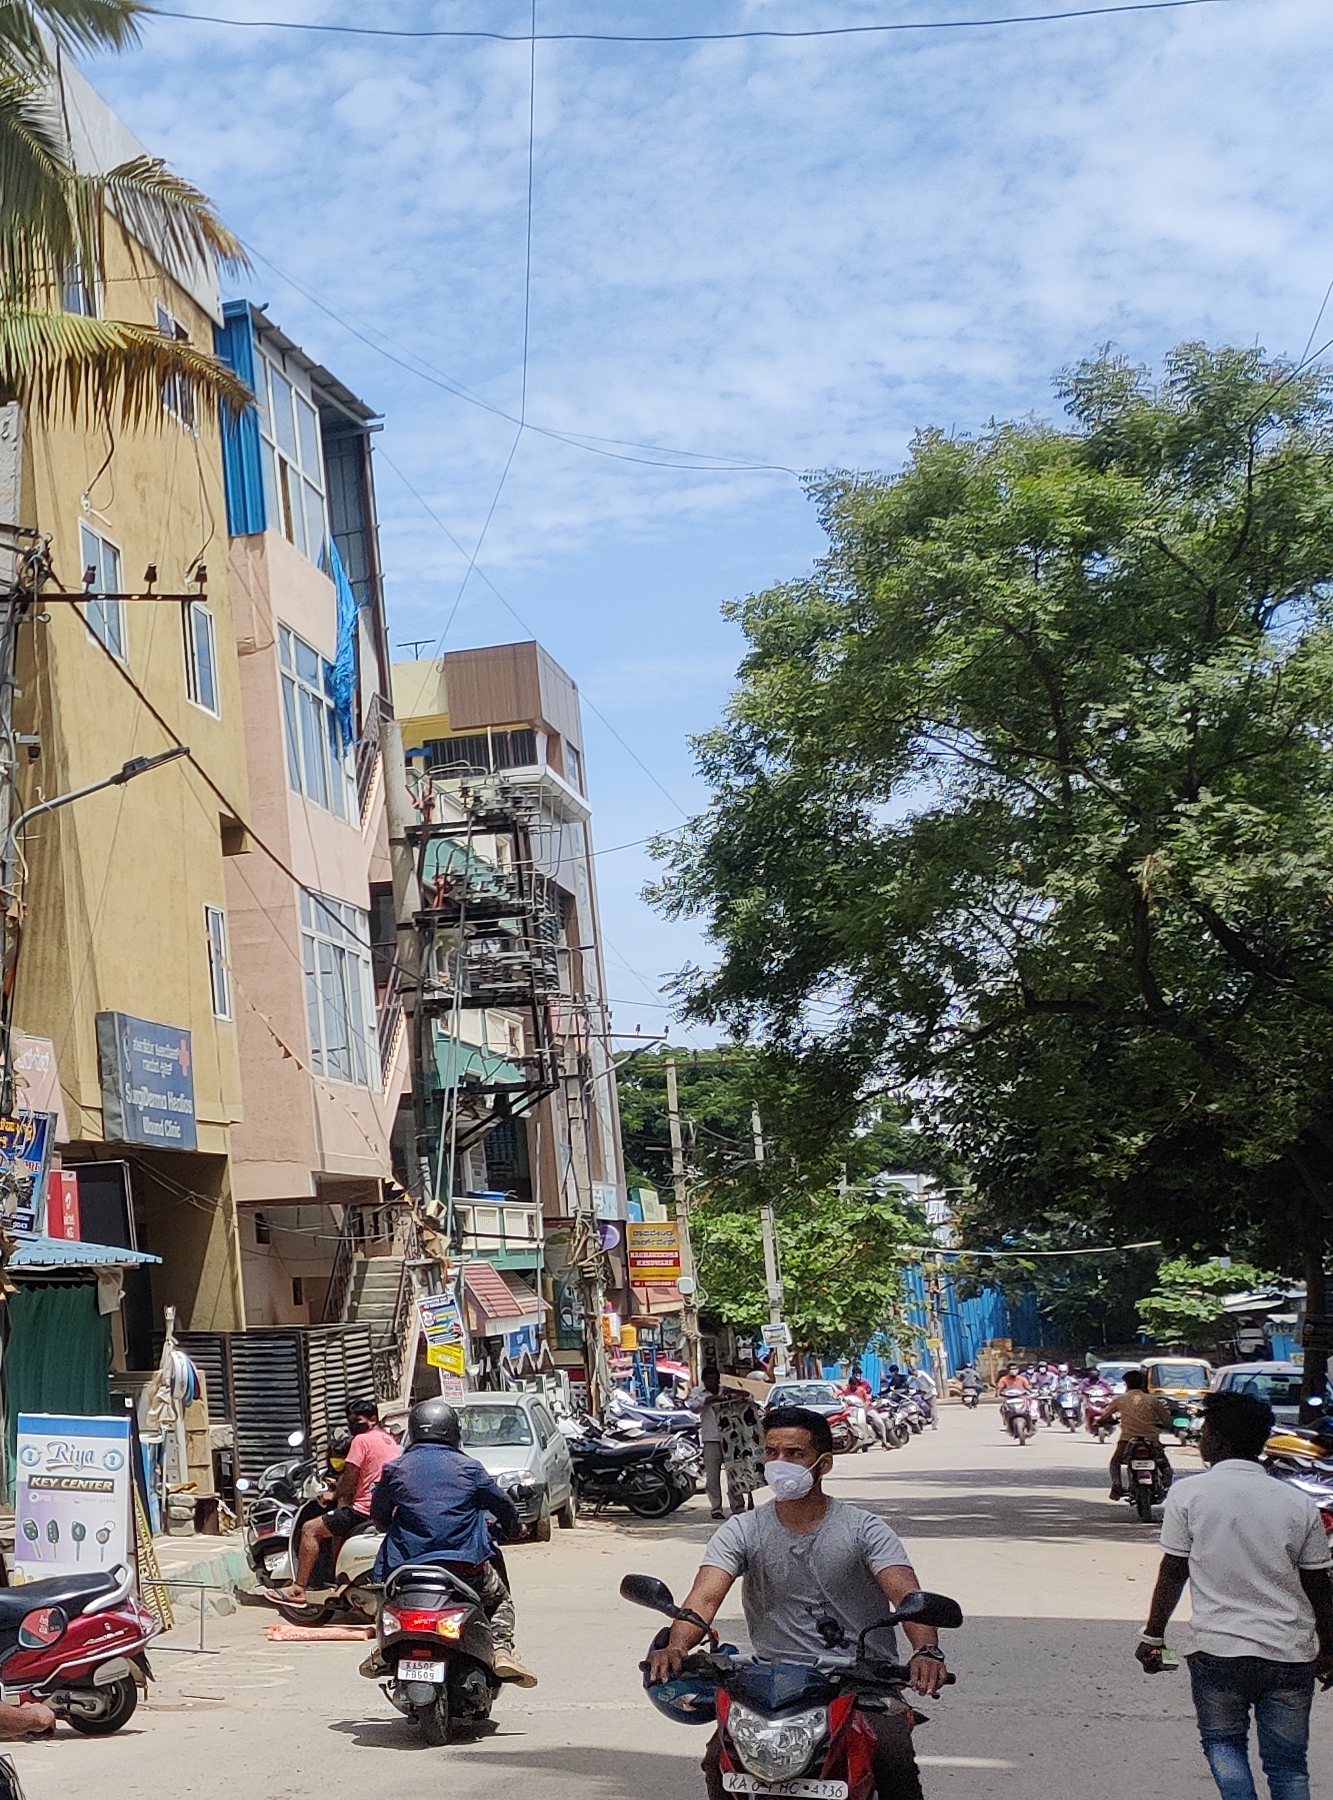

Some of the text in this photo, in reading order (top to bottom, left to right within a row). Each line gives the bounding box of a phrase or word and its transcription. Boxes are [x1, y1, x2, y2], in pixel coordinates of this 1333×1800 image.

[45, 1441, 95, 1471] Riya
[30, 1476, 114, 1492] KEY CENTER
